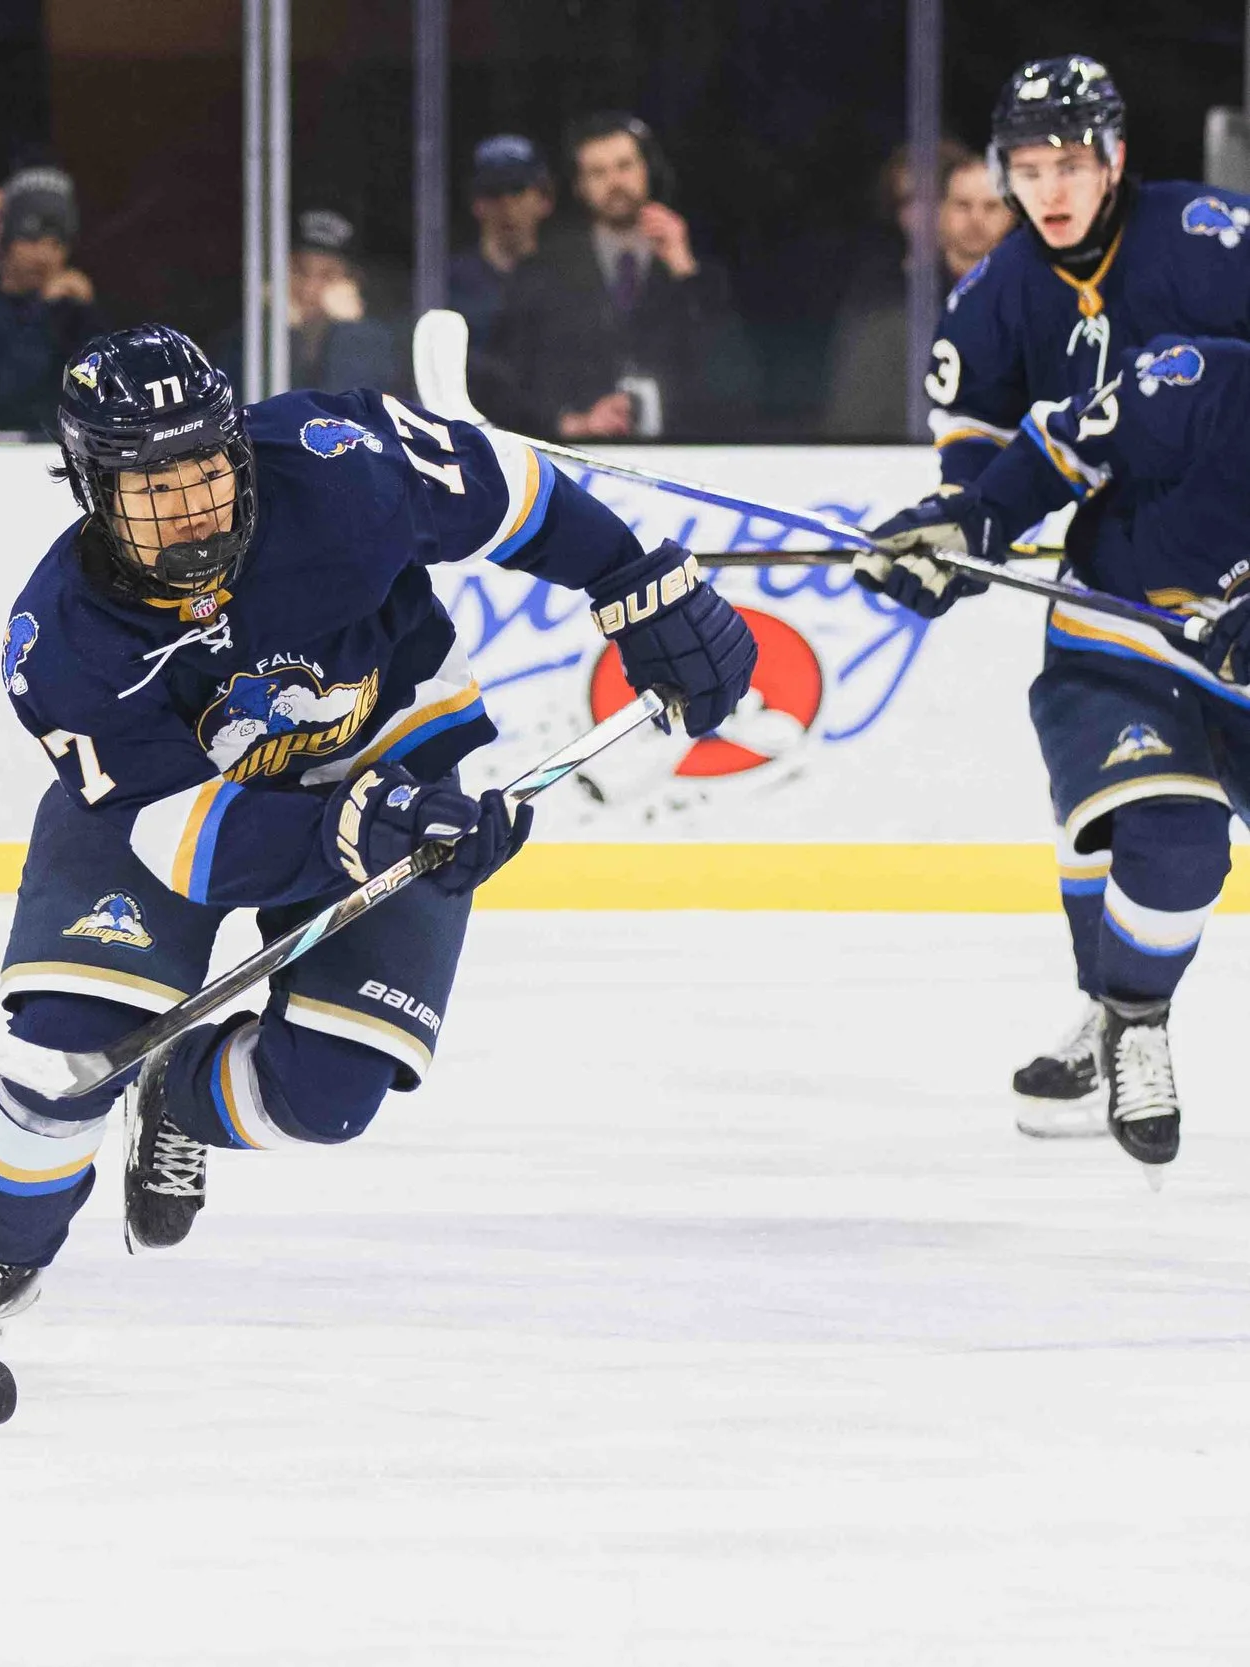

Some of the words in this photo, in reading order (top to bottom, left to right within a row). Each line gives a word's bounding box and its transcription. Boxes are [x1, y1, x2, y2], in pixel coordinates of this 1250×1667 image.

[145, 375, 184, 409] 77
[153, 419, 204, 442] BAUER
[255, 652, 324, 679] FALLS
[357, 979, 442, 1036] BAUER
